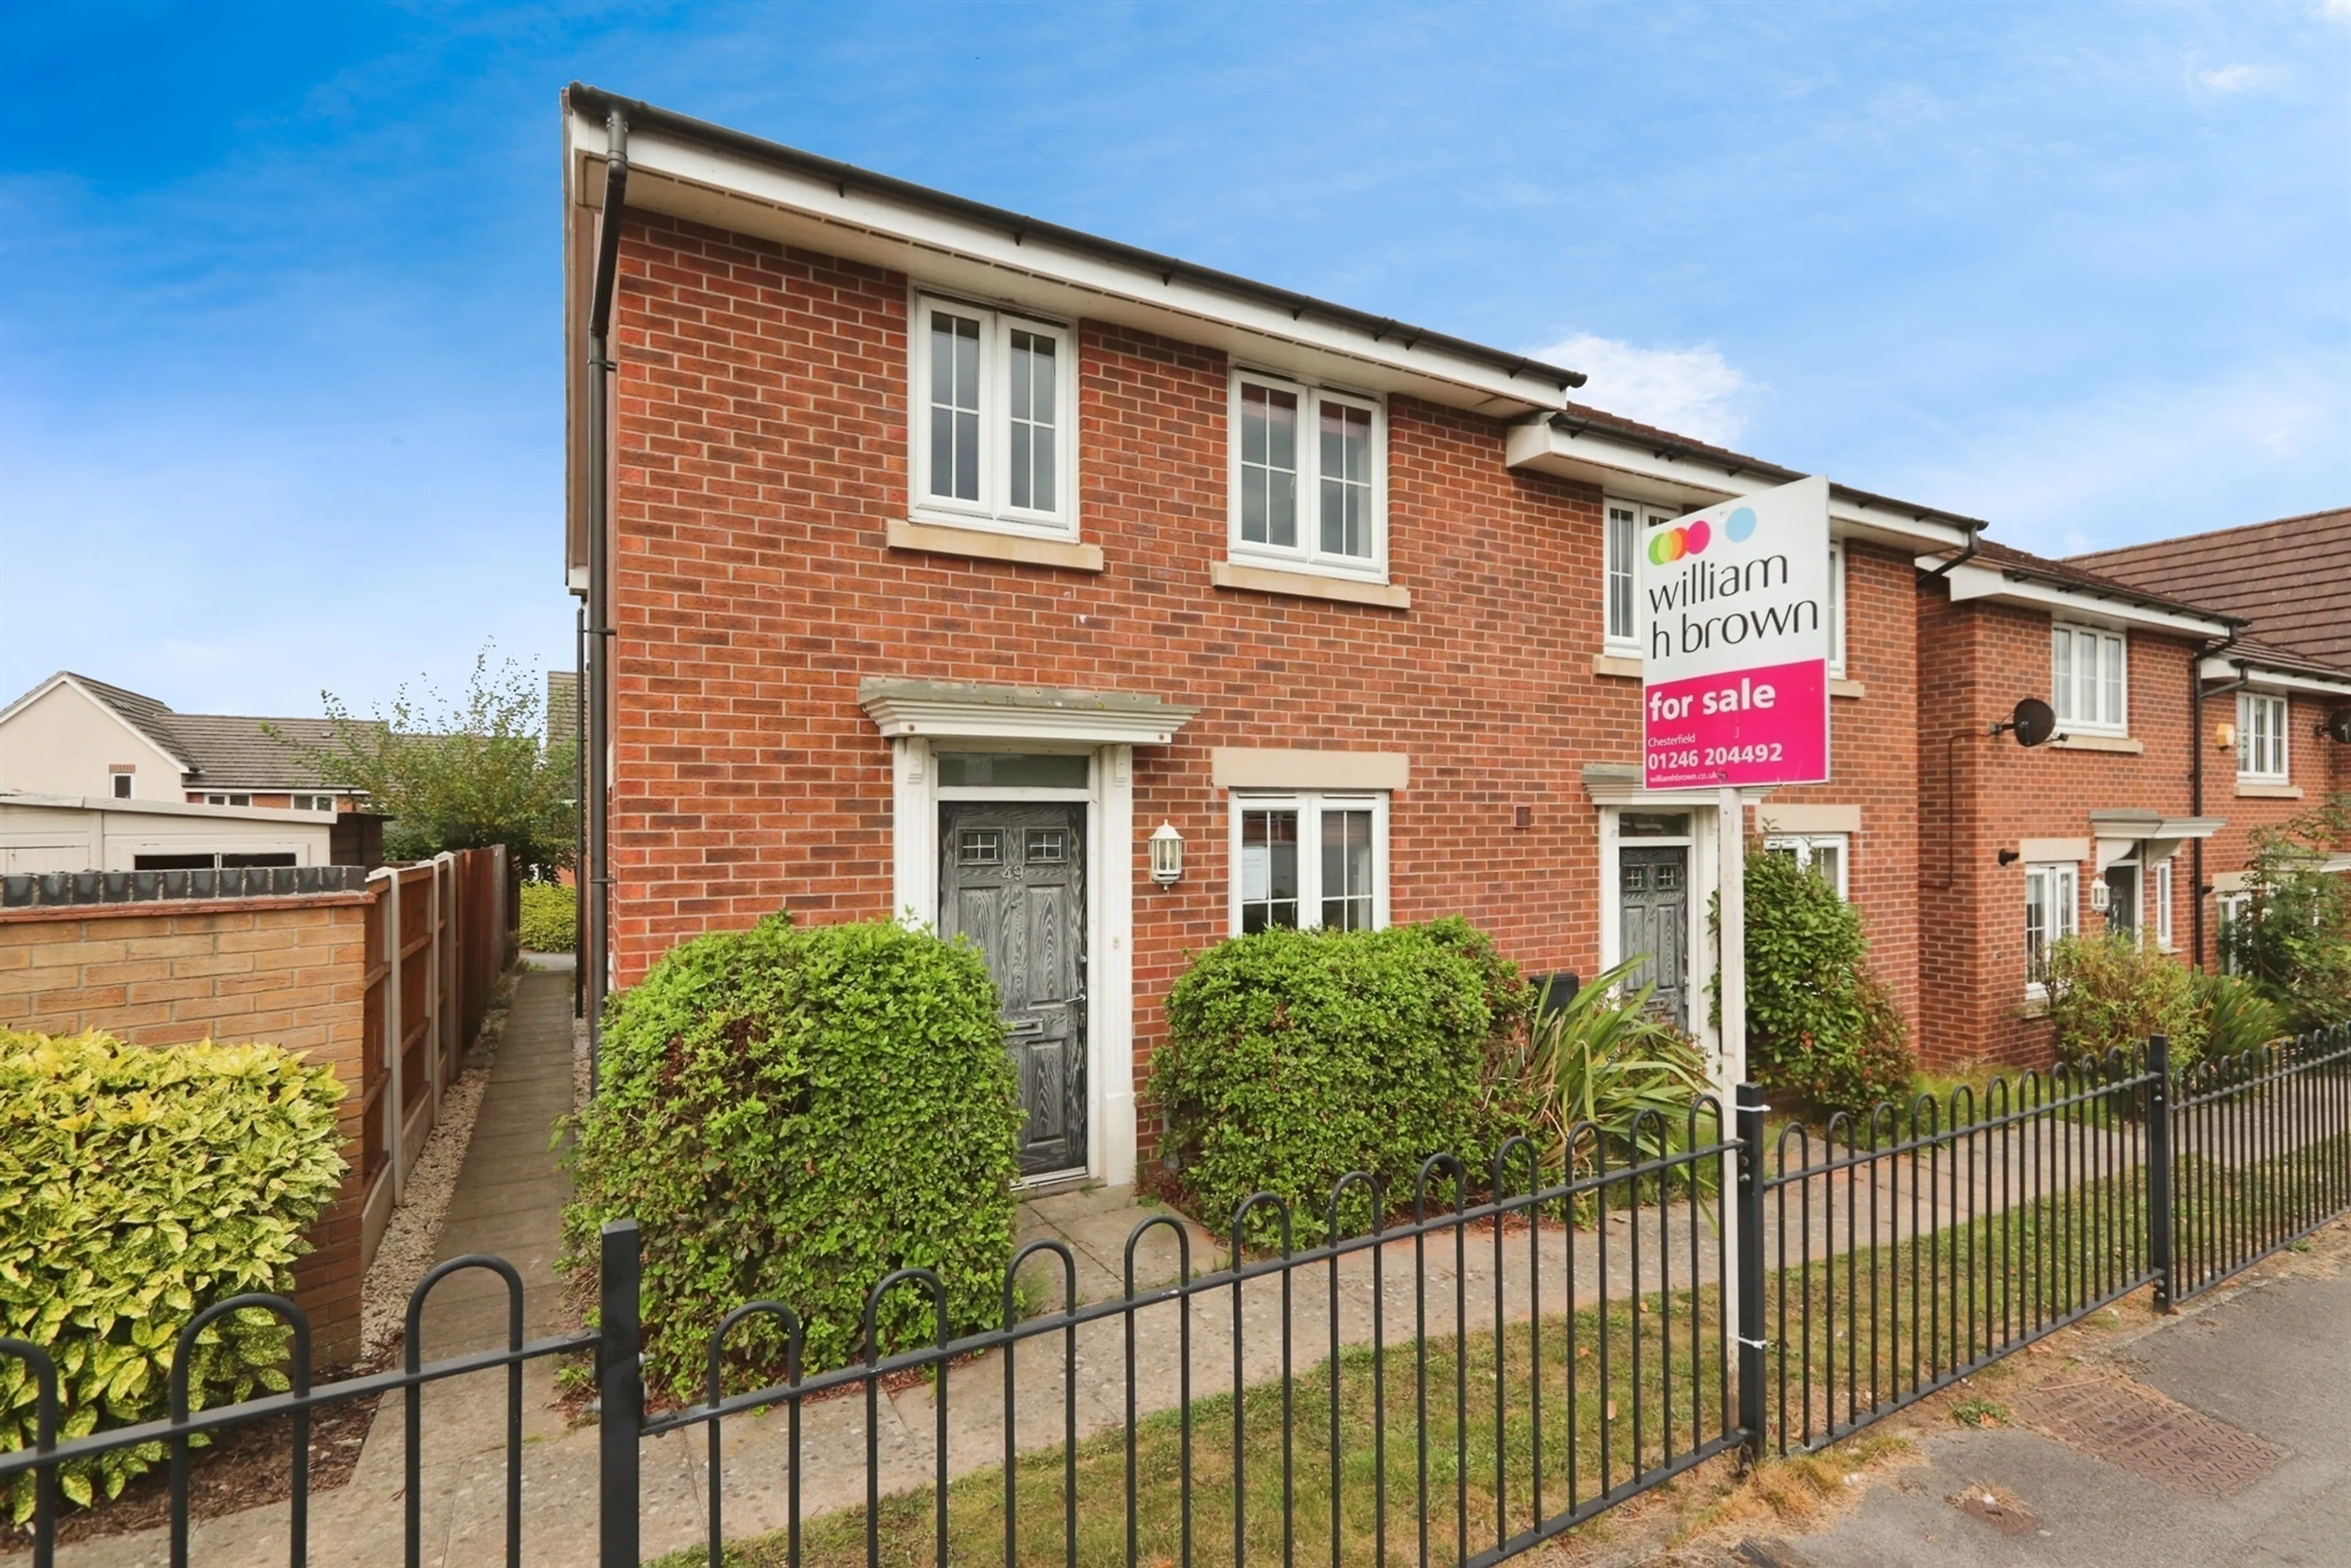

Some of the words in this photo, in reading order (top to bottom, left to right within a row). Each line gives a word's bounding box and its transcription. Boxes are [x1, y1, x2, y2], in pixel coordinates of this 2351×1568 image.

[1649, 554, 1788, 614] william
[1652, 621, 1670, 660] h
[1682, 599, 1818, 653] brown
[1649, 691, 1693, 722] for
[1702, 677, 1776, 715] sale
[1648, 733, 1696, 748] Chesterfield
[1648, 749, 1699, 770] 01246
[1704, 743, 1783, 767] 204492
[1649, 771, 1718, 784] williamhbrown.co.uk
[1002, 865, 1024, 882] 49
